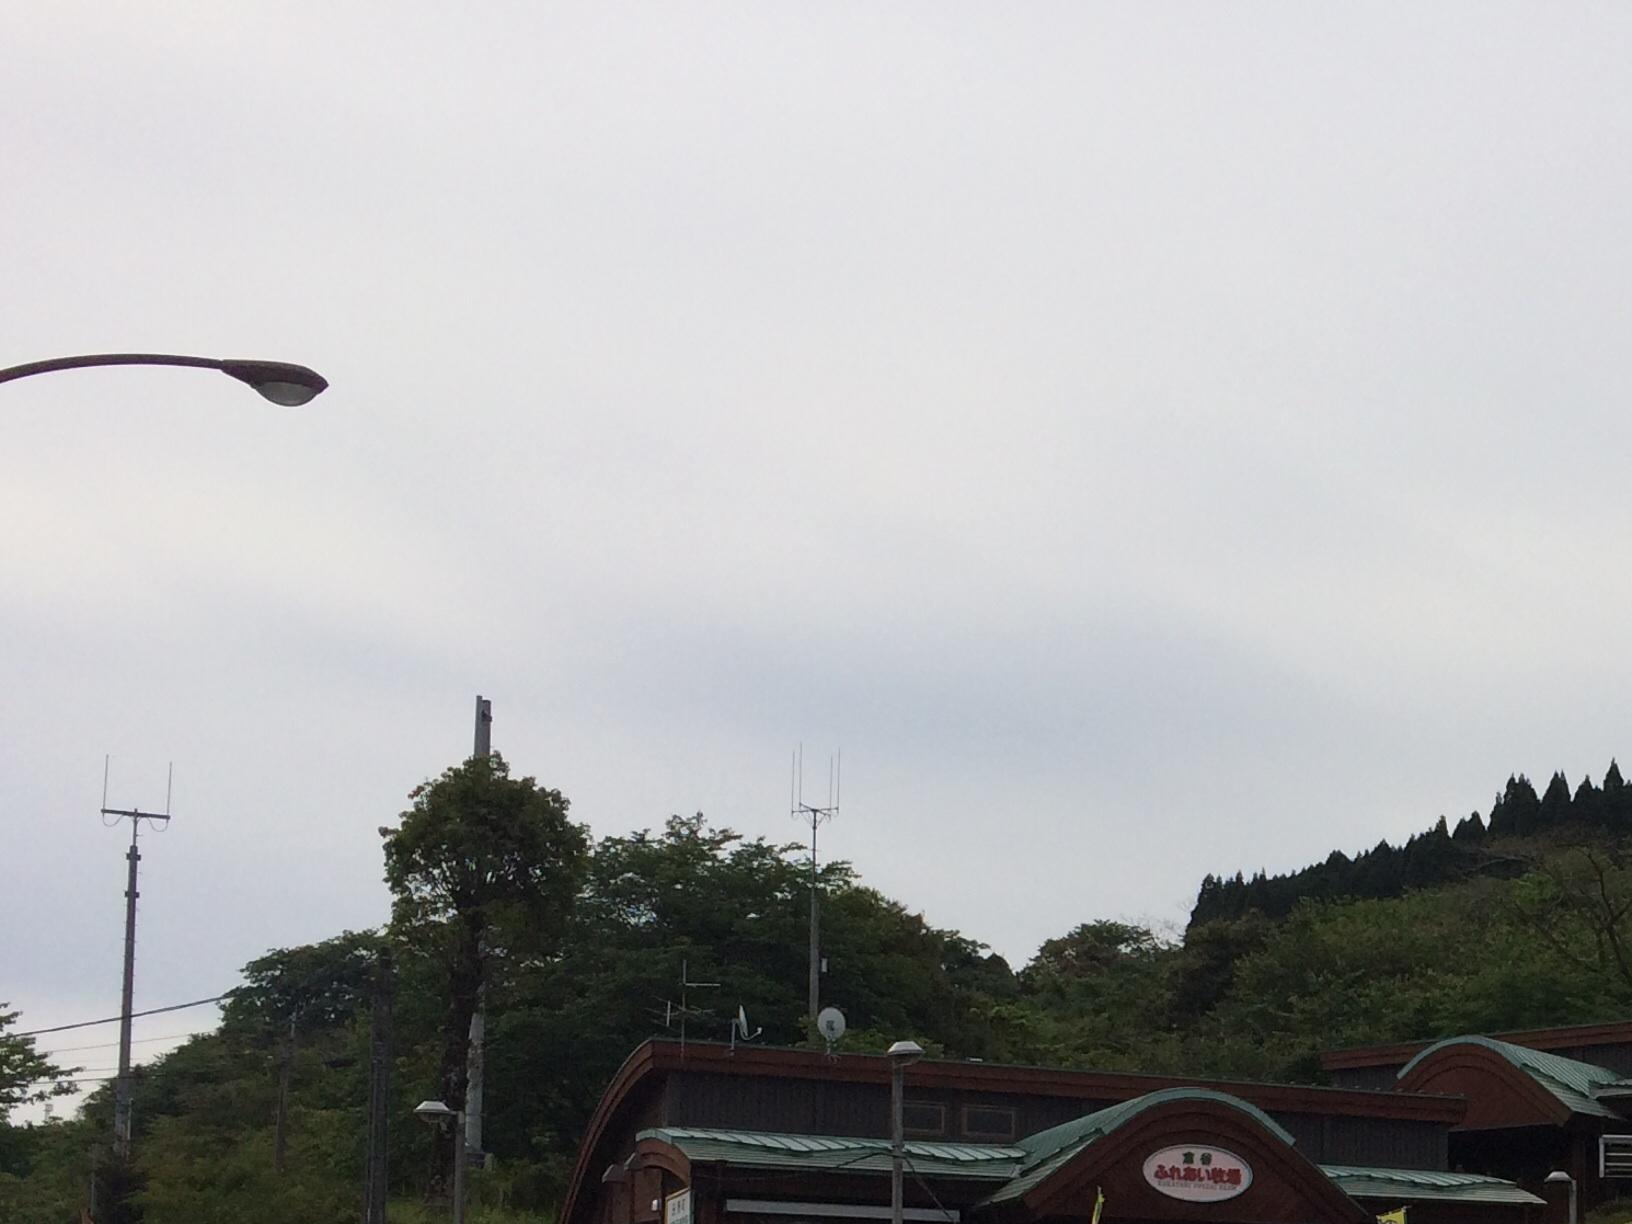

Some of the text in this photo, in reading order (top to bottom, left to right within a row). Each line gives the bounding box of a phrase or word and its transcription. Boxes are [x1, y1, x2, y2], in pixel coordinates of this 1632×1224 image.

[1154, 1164, 1242, 1186] ふれあい牧場
